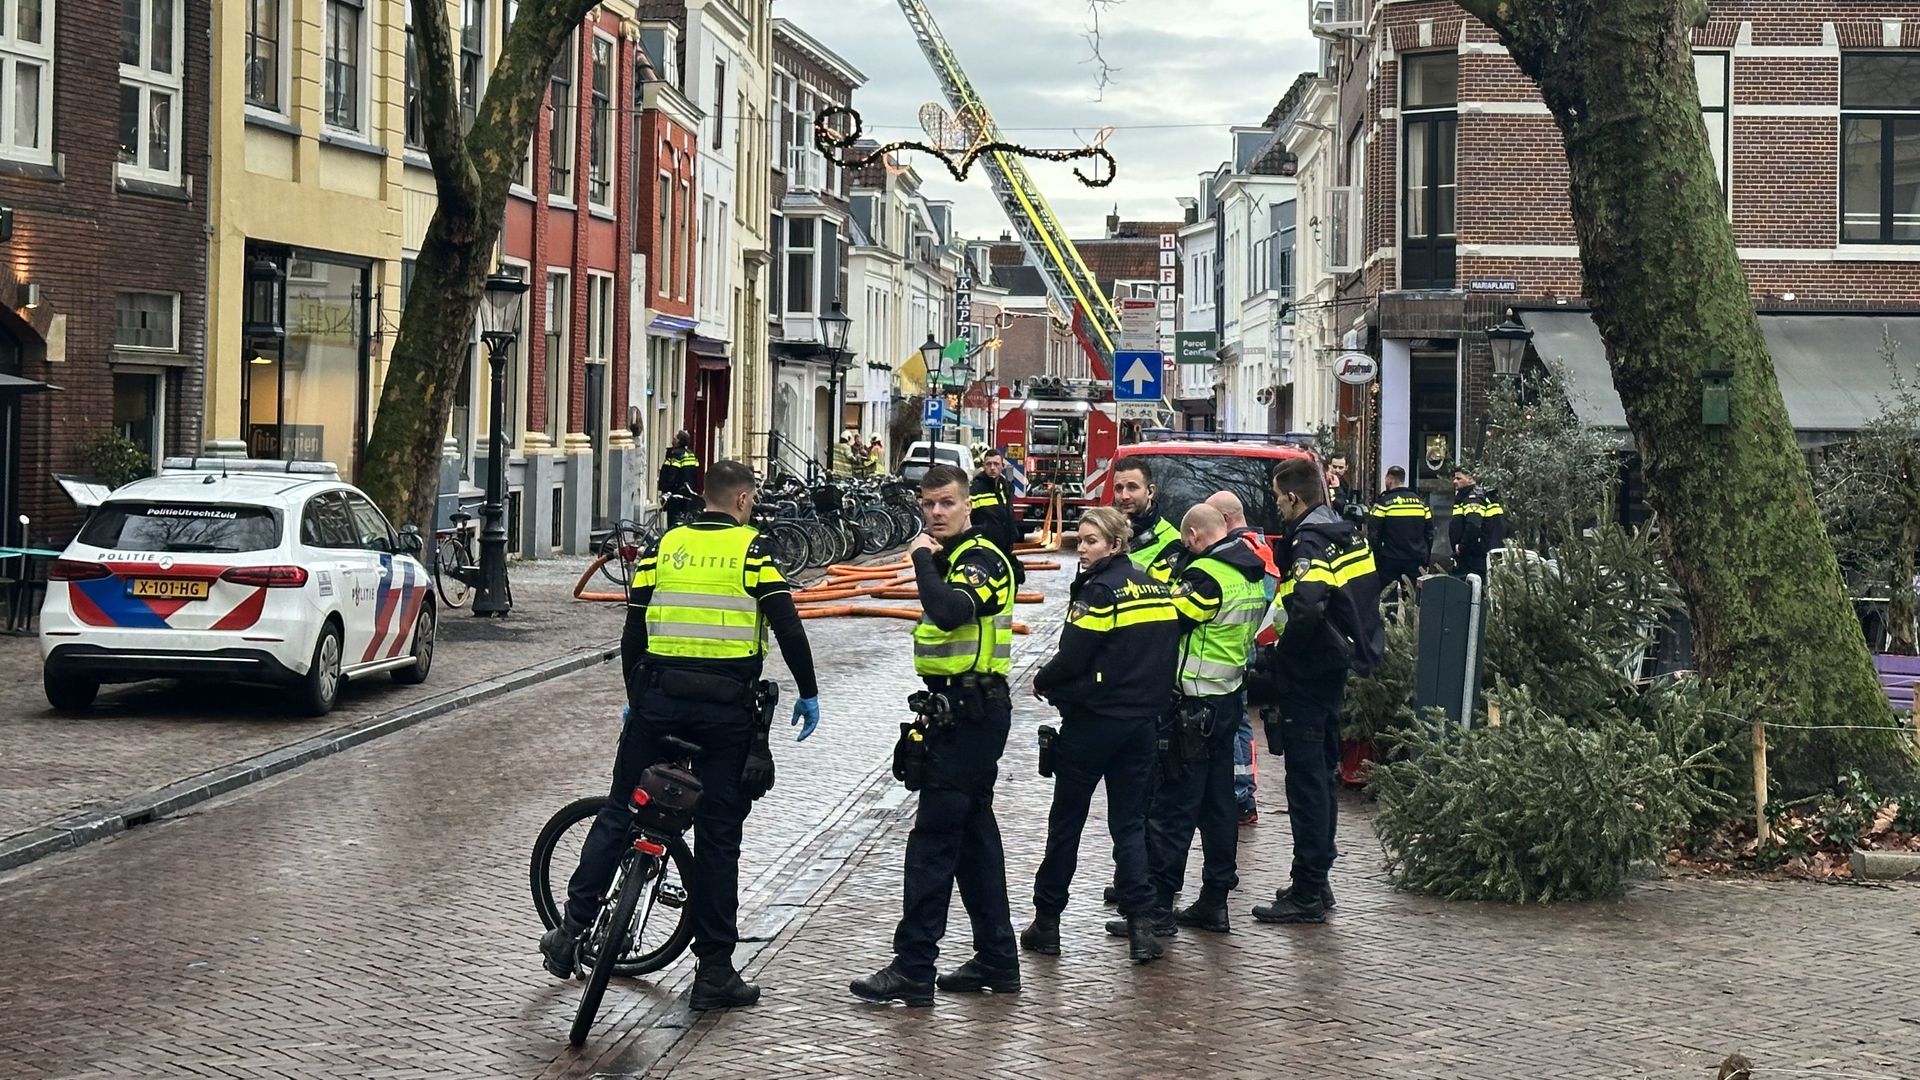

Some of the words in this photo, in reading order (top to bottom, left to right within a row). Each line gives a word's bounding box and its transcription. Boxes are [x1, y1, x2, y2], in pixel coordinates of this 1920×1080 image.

[1472, 282, 1515, 290] MARIAPLAATS
[928, 401, 939, 416] P
[147, 508, 236, 519] PolitieUtrechtZuid
[98, 553, 154, 561] POLITIE
[662, 549, 738, 570] POLITIE
[140, 581, 199, 595] X-101-HG
[1124, 581, 1161, 598] POLITIE
